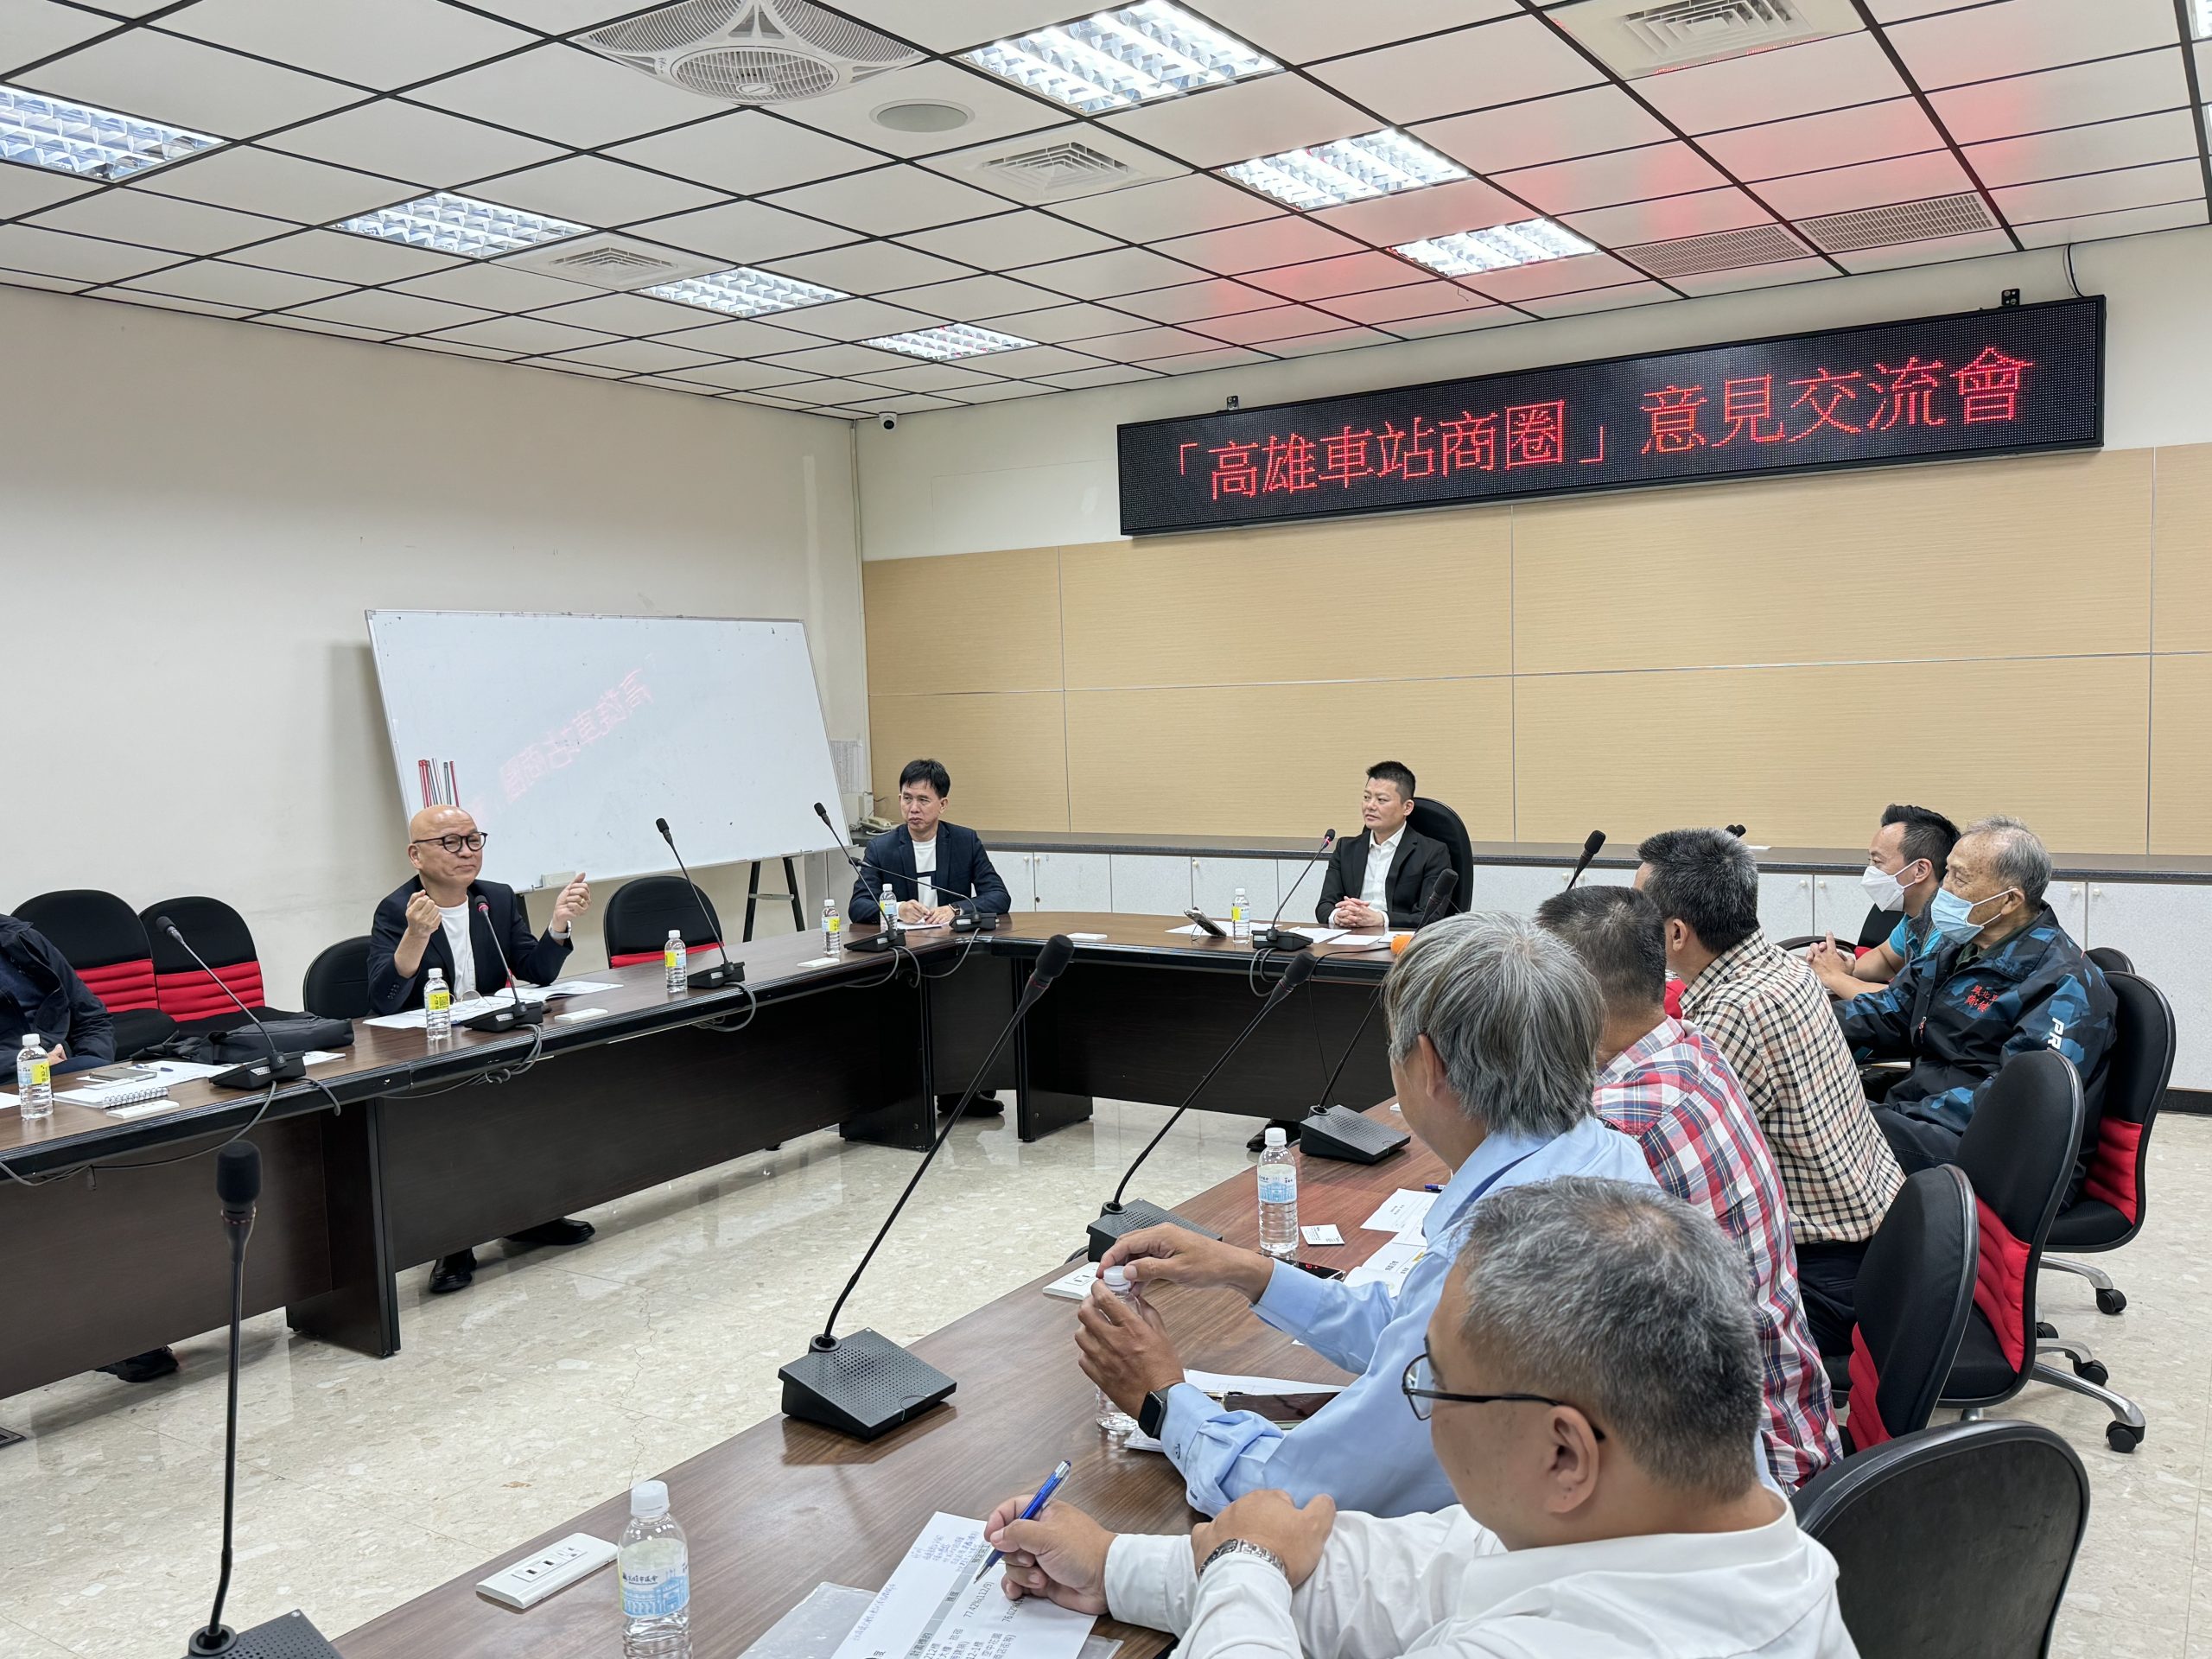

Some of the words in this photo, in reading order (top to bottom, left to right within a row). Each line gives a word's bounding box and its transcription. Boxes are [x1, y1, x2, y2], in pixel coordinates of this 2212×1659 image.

[1180, 346, 2033, 501] 「高雄車站商圈」意見交流會
